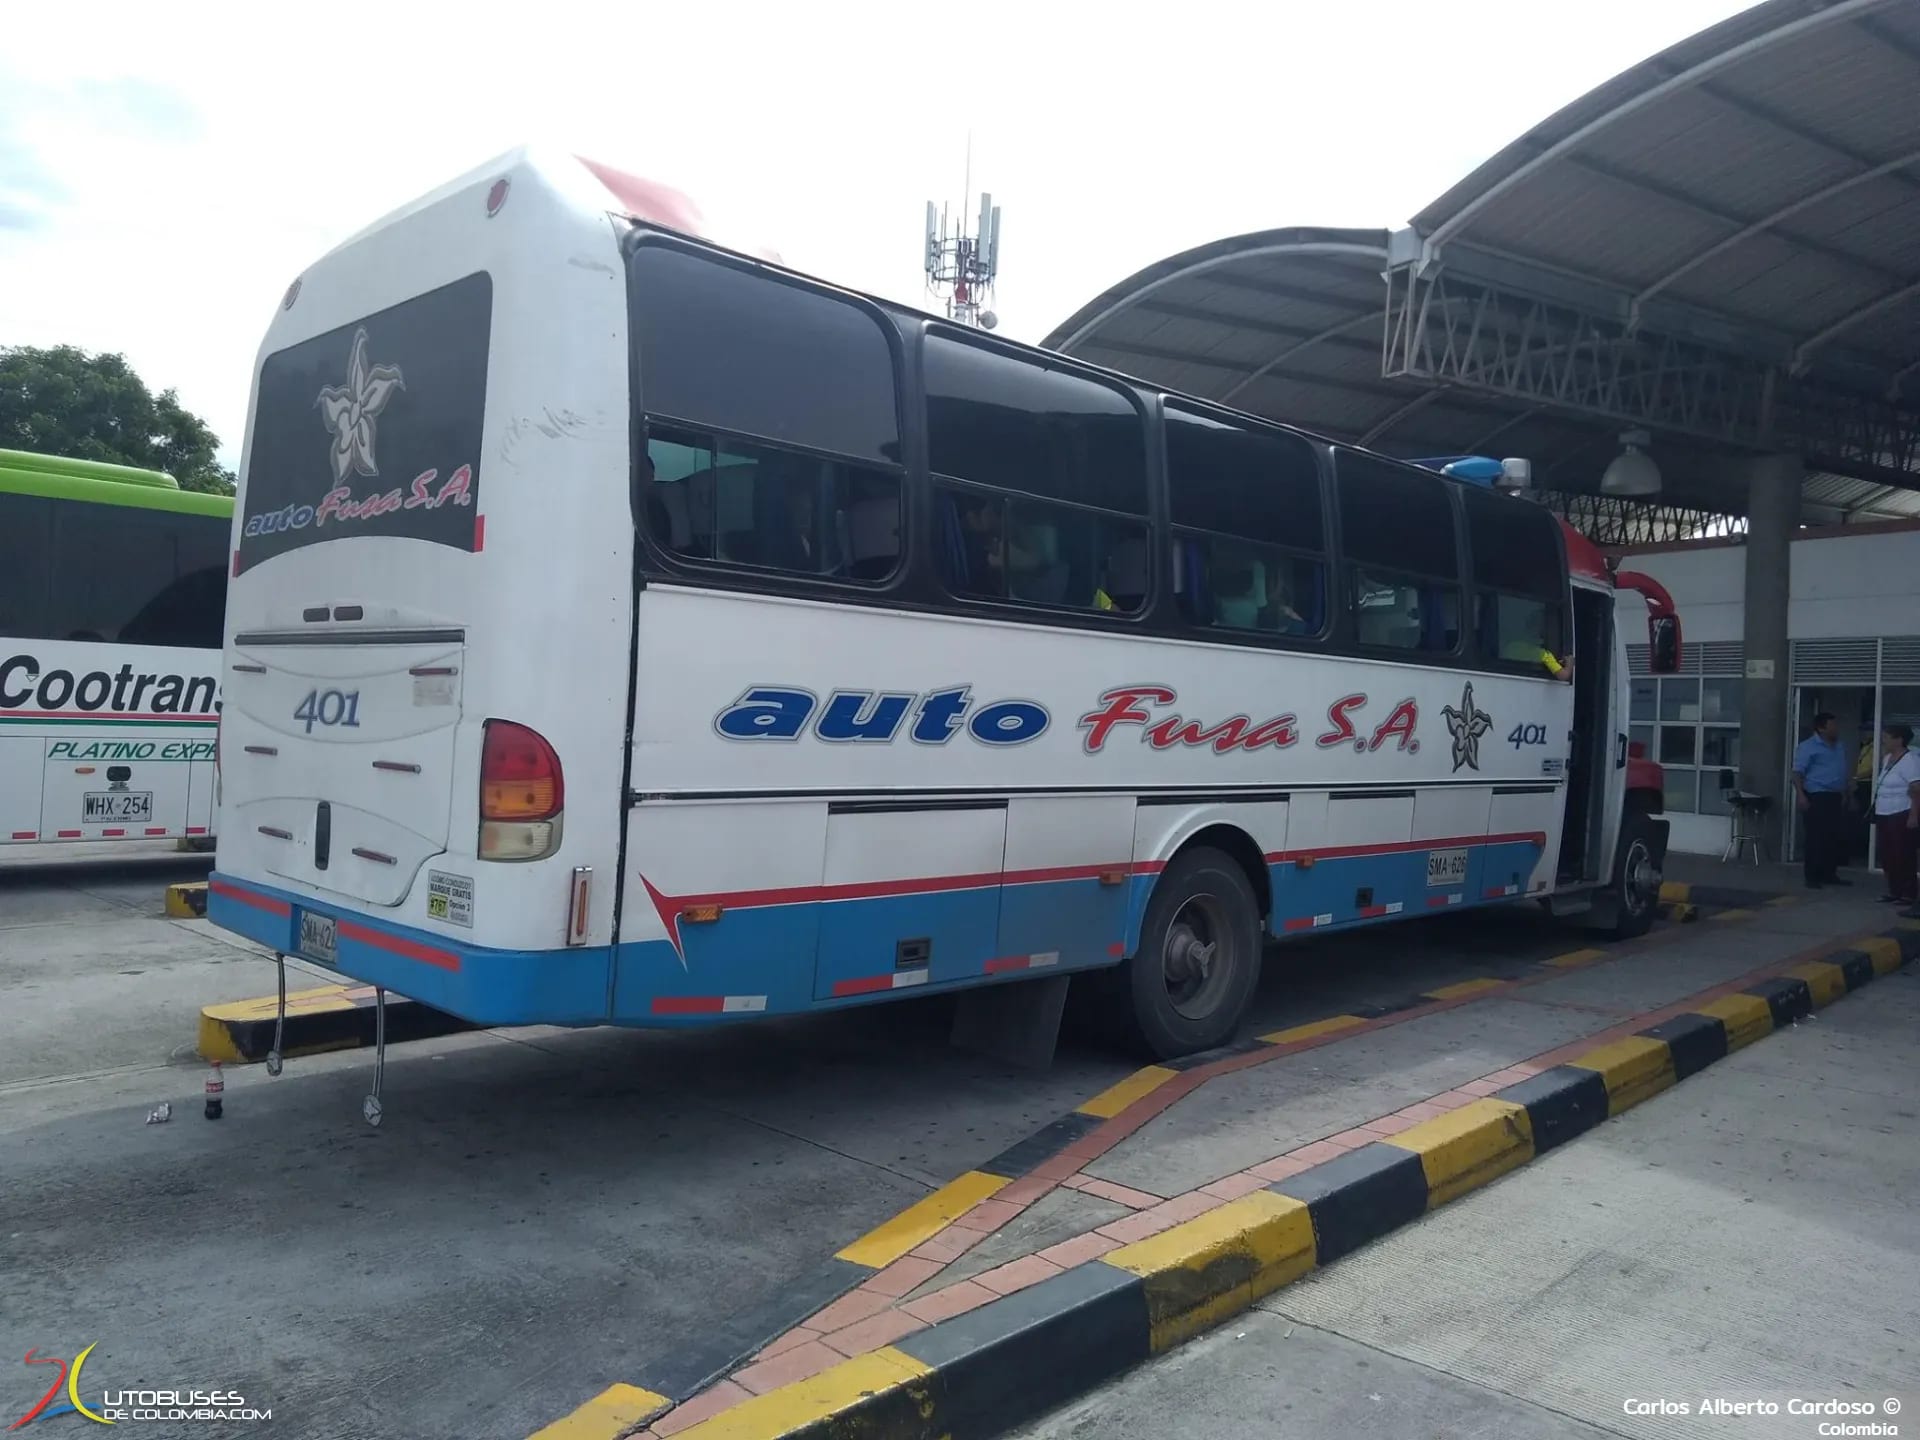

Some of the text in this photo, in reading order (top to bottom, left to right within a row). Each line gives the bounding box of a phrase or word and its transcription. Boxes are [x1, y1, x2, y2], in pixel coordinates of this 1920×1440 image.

[245, 504, 315, 537] auto
[315, 486, 402, 527] Fusa
[0, 655, 223, 713] Cootran
[294, 689, 360, 734] 401
[712, 682, 1420, 754] auto Fusa S.A.
[48, 742, 156, 758] PLATINO
[1508, 723, 1547, 750] 401
[86, 797, 149, 815] WHX 254
